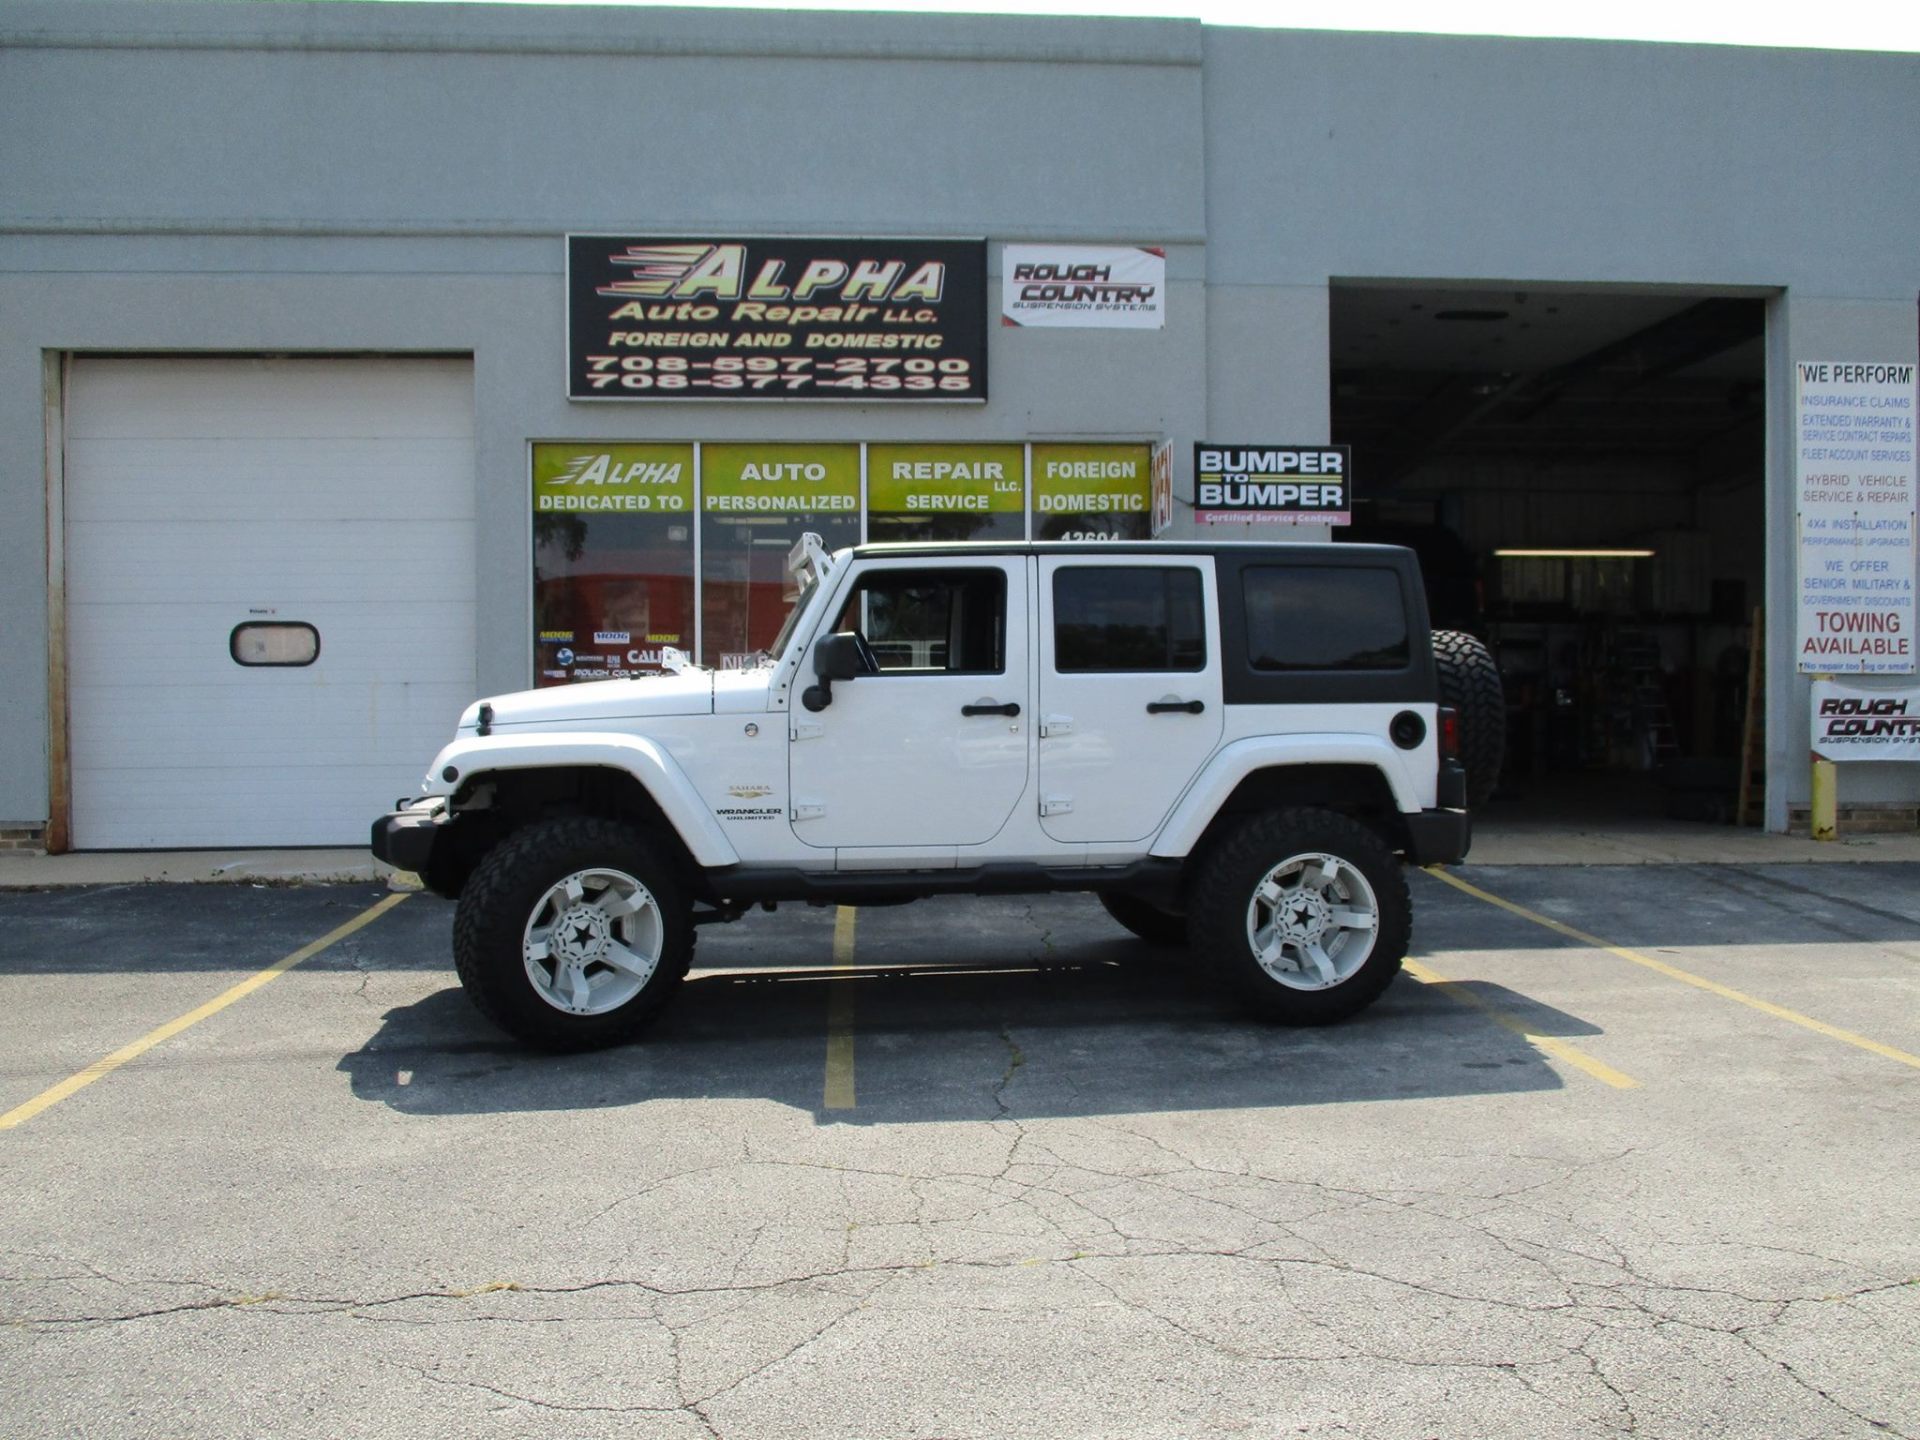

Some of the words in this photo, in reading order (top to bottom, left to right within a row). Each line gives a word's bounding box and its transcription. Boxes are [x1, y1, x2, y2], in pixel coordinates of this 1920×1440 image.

[672, 244, 945, 301] ALPHA
[1013, 263, 1111, 282] ROUGH
[1020, 285, 1155, 303] COUNTRY
[609, 301, 719, 321] Auto
[732, 303, 878, 325] Repair
[883, 310, 939, 323] LLC.
[1012, 302, 1092, 310] SUSPENSION
[1095, 302, 1156, 311] SYSTEMS
[609, 332, 729, 348] FOREIGN
[733, 333, 792, 348] AND
[805, 334, 943, 349] DOMESTIC
[586, 356, 970, 373] 708-597-2700
[586, 373, 971, 390] 708-377-4335
[1803, 365, 1828, 383] WE
[1833, 365, 1910, 384] PERFORM
[1801, 396, 1867, 407] INSURANCE
[1870, 397, 1910, 408] CLAIMS
[1803, 414, 1850, 427] EXTENDED
[1854, 416, 1902, 428] WARRANTY
[1905, 417, 1911, 428] &
[1803, 430, 1835, 441] SERVICE
[1838, 431, 1878, 442] CONTRACT
[1880, 432, 1912, 443] REPAIRS
[1200, 451, 1343, 473] BUMPER
[1802, 449, 1828, 460] FLEET
[1829, 450, 1868, 461] ACCOUNT
[1872, 451, 1911, 462] SERVICES
[576, 454, 682, 485] ALPHA
[740, 463, 826, 481] AUTO
[893, 462, 1004, 480] REPAIR
[994, 481, 1022, 492] LLC.
[1047, 462, 1136, 478] FOREIGN
[1223, 473, 1249, 483] TO
[1806, 475, 1850, 486] HYBRID
[1858, 475, 1907, 487] VEHICLE
[540, 495, 651, 510] DEDICATED
[659, 495, 683, 510] TO
[706, 495, 855, 510] PERSONALIZED
[906, 495, 989, 509] SERVICE
[1039, 494, 1143, 511] DOMESTIC
[1200, 484, 1343, 506] BUMPER
[1803, 491, 1853, 502] SERVICE
[1857, 492, 1864, 502] &
[1867, 492, 1909, 503] REPAIR
[1205, 513, 1253, 522] Certified
[1256, 513, 1296, 522] Service
[1807, 519, 1827, 529] 4X4
[1832, 520, 1907, 530] INSTALLATION
[1803, 537, 1863, 546] PERFORMANCE
[1866, 538, 1910, 546] UPGRADES
[1825, 560, 1844, 571] WE
[1850, 560, 1889, 572] OFFER
[1804, 578, 1846, 589] SENIOR
[1852, 579, 1901, 590] MILITARY
[1904, 580, 1910, 590] &
[1803, 595, 1862, 606] GOVERNMENT
[1864, 597, 1911, 607] DISCOUNTS
[1816, 612, 1900, 633] TOWING
[645, 634, 679, 642] MOOG
[1803, 638, 1909, 655] AVAILABLE
[1820, 699, 1908, 715] ROUGH
